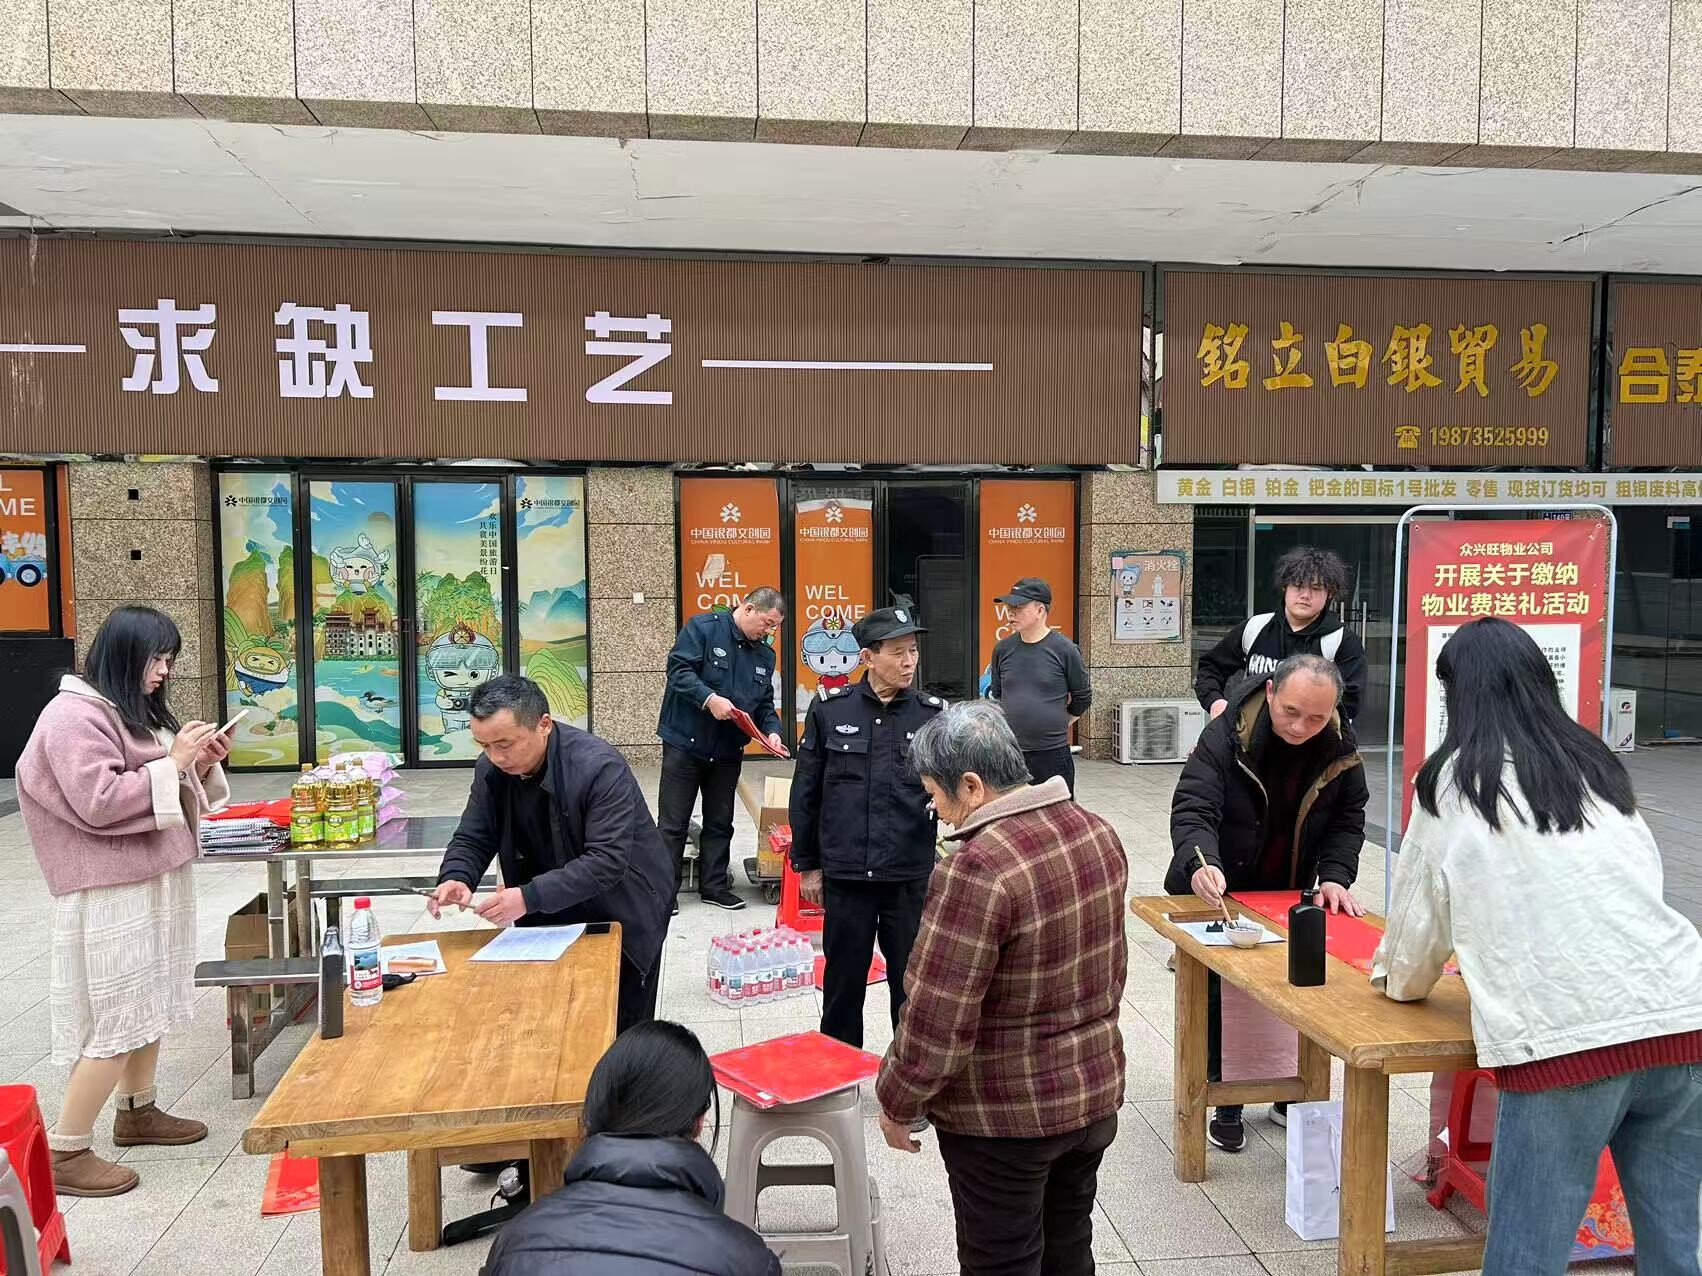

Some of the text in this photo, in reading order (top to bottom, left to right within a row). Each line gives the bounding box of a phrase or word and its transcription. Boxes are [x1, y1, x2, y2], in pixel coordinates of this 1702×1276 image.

[118, 299, 673, 405] 求缺工艺
[1429, 426, 1549, 446] 19873525999
[1177, 477, 1212, 497] 黄金
[1221, 478, 1256, 497] 白银
[1265, 478, 1299, 497] 铂金
[1309, 478, 1457, 498] 钯金的国标1号批发
[1466, 479, 1498, 498] 零售
[1507, 479, 1608, 498] 现货订货均可
[690, 527, 771, 539] 中国银都文创园
[800, 527, 868, 538] 中国银都文创园
[988, 527, 1065, 539] 中国银都文创园
[489, 512, 498, 575] 欢乐中国旅游日
[1459, 542, 1553, 556] 众兴旺物业公司
[1144, 559, 1179, 572] 消火栓
[696, 572, 747, 588] WEL
[1434, 562, 1579, 587] 开展关于缴纳
[805, 585, 849, 600] WEL
[697, 593, 749, 611] COM
[1421, 591, 1590, 617] 物业费送礼活动
[805, 604, 866, 620] COME
